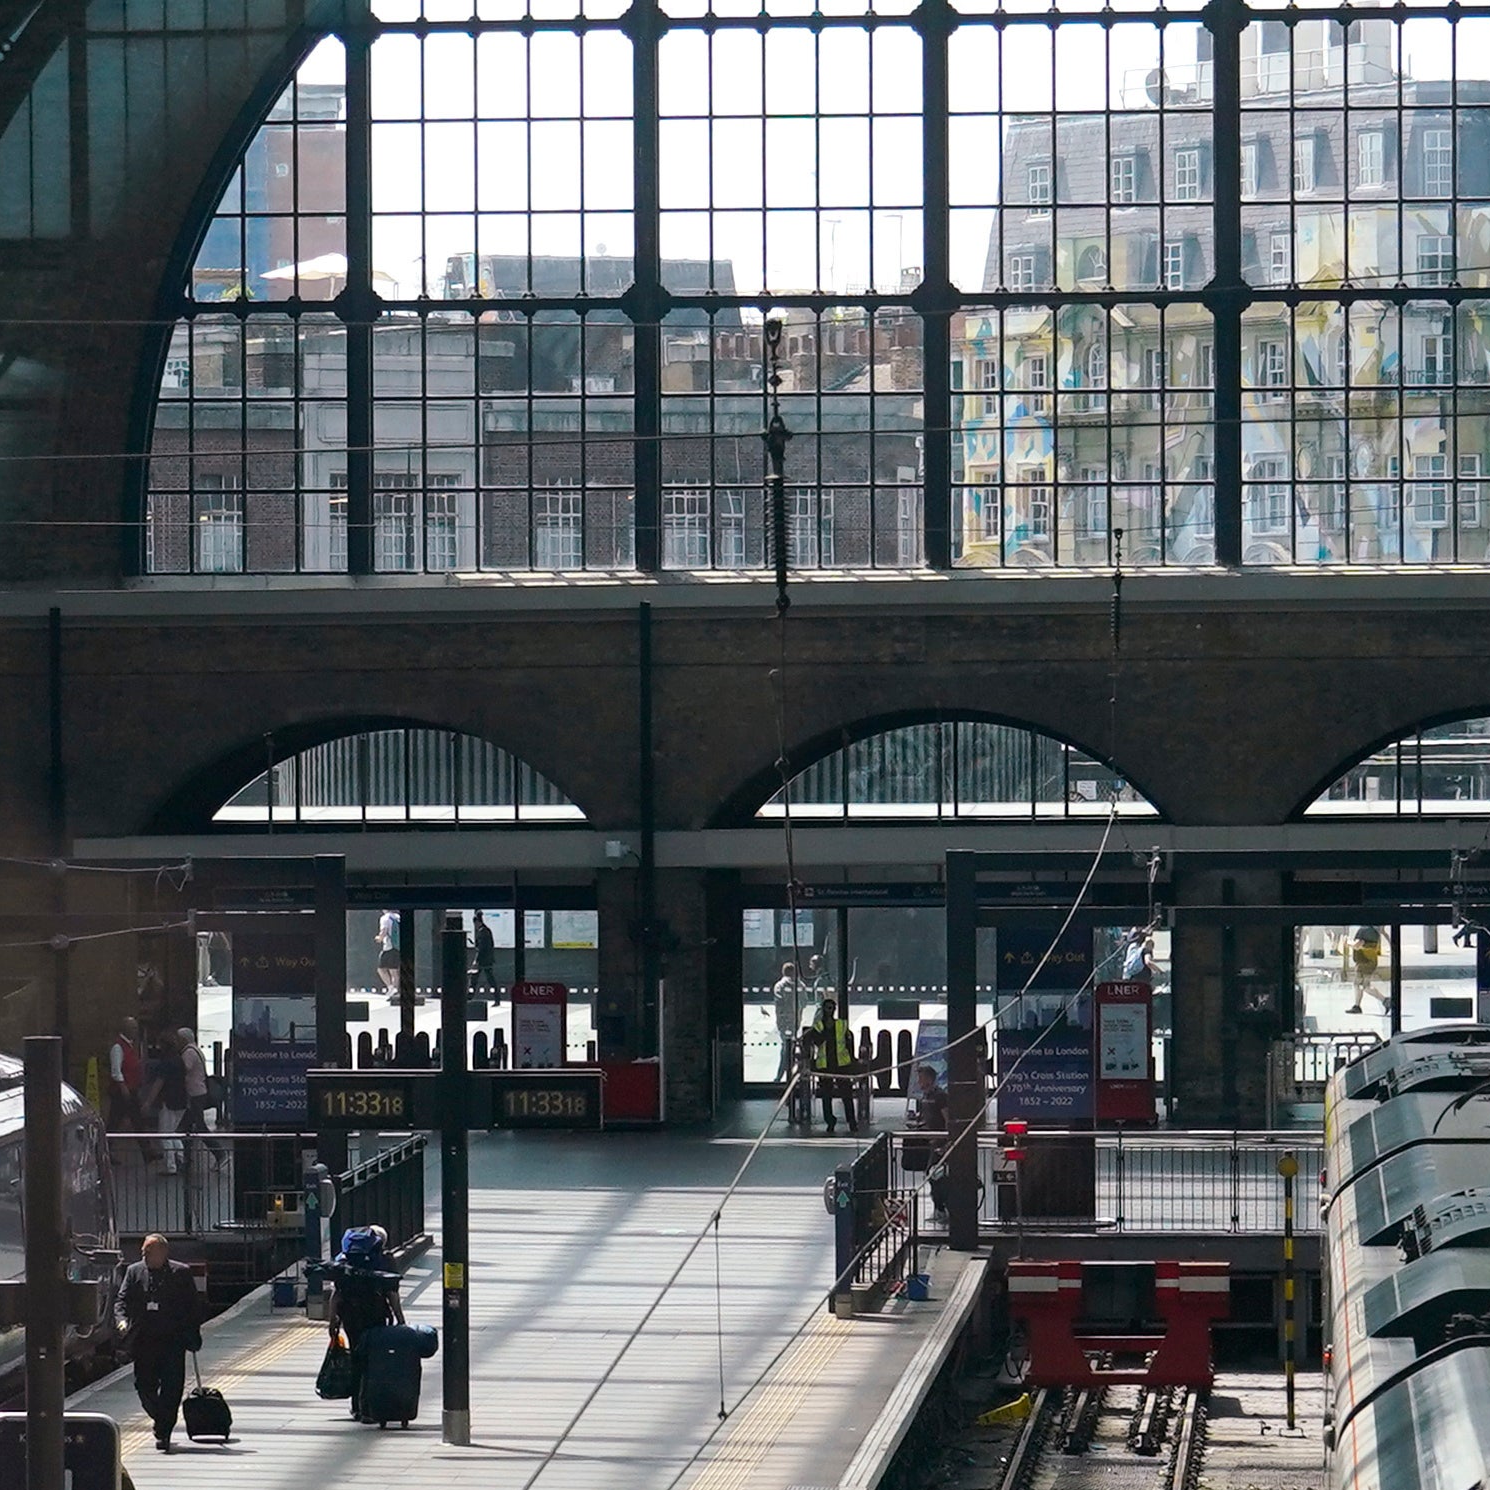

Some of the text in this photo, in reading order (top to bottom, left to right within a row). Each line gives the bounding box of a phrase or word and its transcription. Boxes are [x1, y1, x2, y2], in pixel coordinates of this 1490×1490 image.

[275, 956, 316, 969] Way Ou
[522, 984, 555, 997] LNER
[1107, 984, 1140, 997] LNER
[238, 1050, 278, 1061] Welcome
[1043, 1047, 1054, 1056] to
[1055, 1046, 1089, 1057] London
[238, 1074, 265, 1085] King's
[266, 1074, 289, 1084] Cross
[1029, 1070, 1055, 1080] Cross
[1055, 1070, 1089, 1080] Station
[1033, 1083, 1087, 1095] Anniversary
[254, 1099, 276, 1110] 1852
[1018, 1096, 1041, 1106] 1852
[1051, 1096, 1074, 1106] 2022
